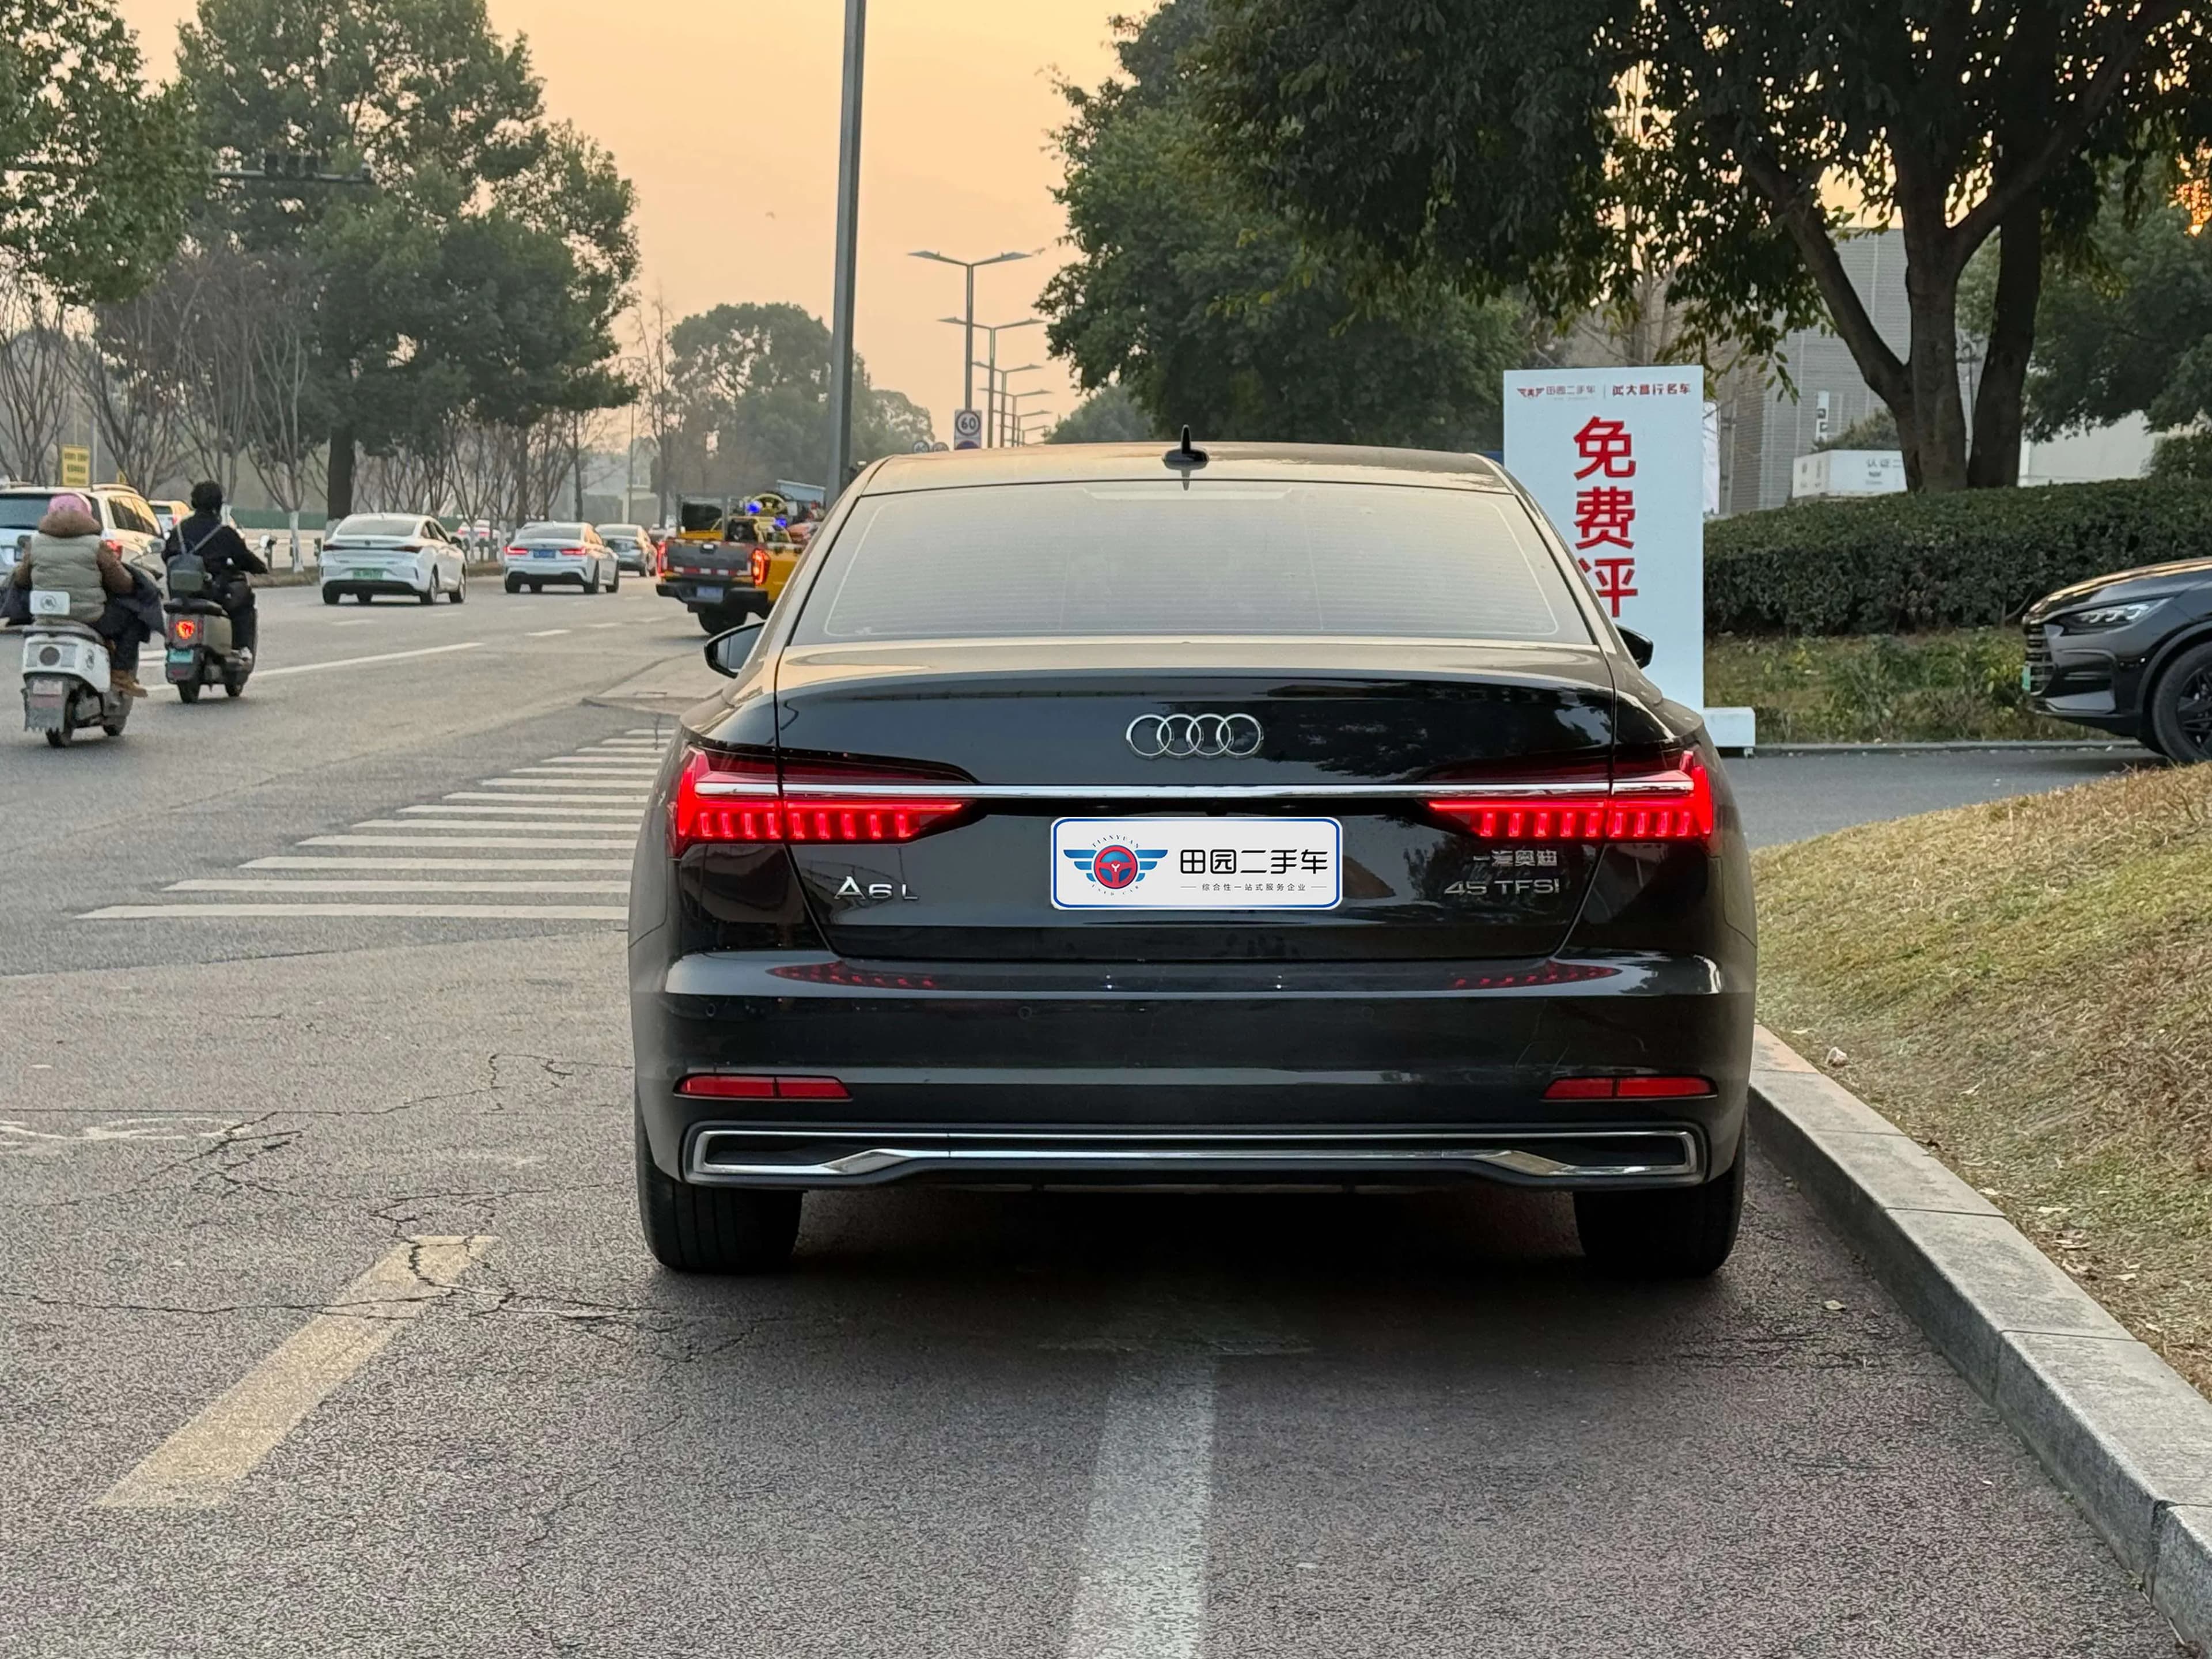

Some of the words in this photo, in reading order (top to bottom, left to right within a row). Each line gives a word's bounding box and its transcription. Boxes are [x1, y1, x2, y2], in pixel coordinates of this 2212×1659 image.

[961, 417, 976, 430] 60
[1444, 880, 1487, 895] 45
[1494, 878, 1560, 895] TFSI
